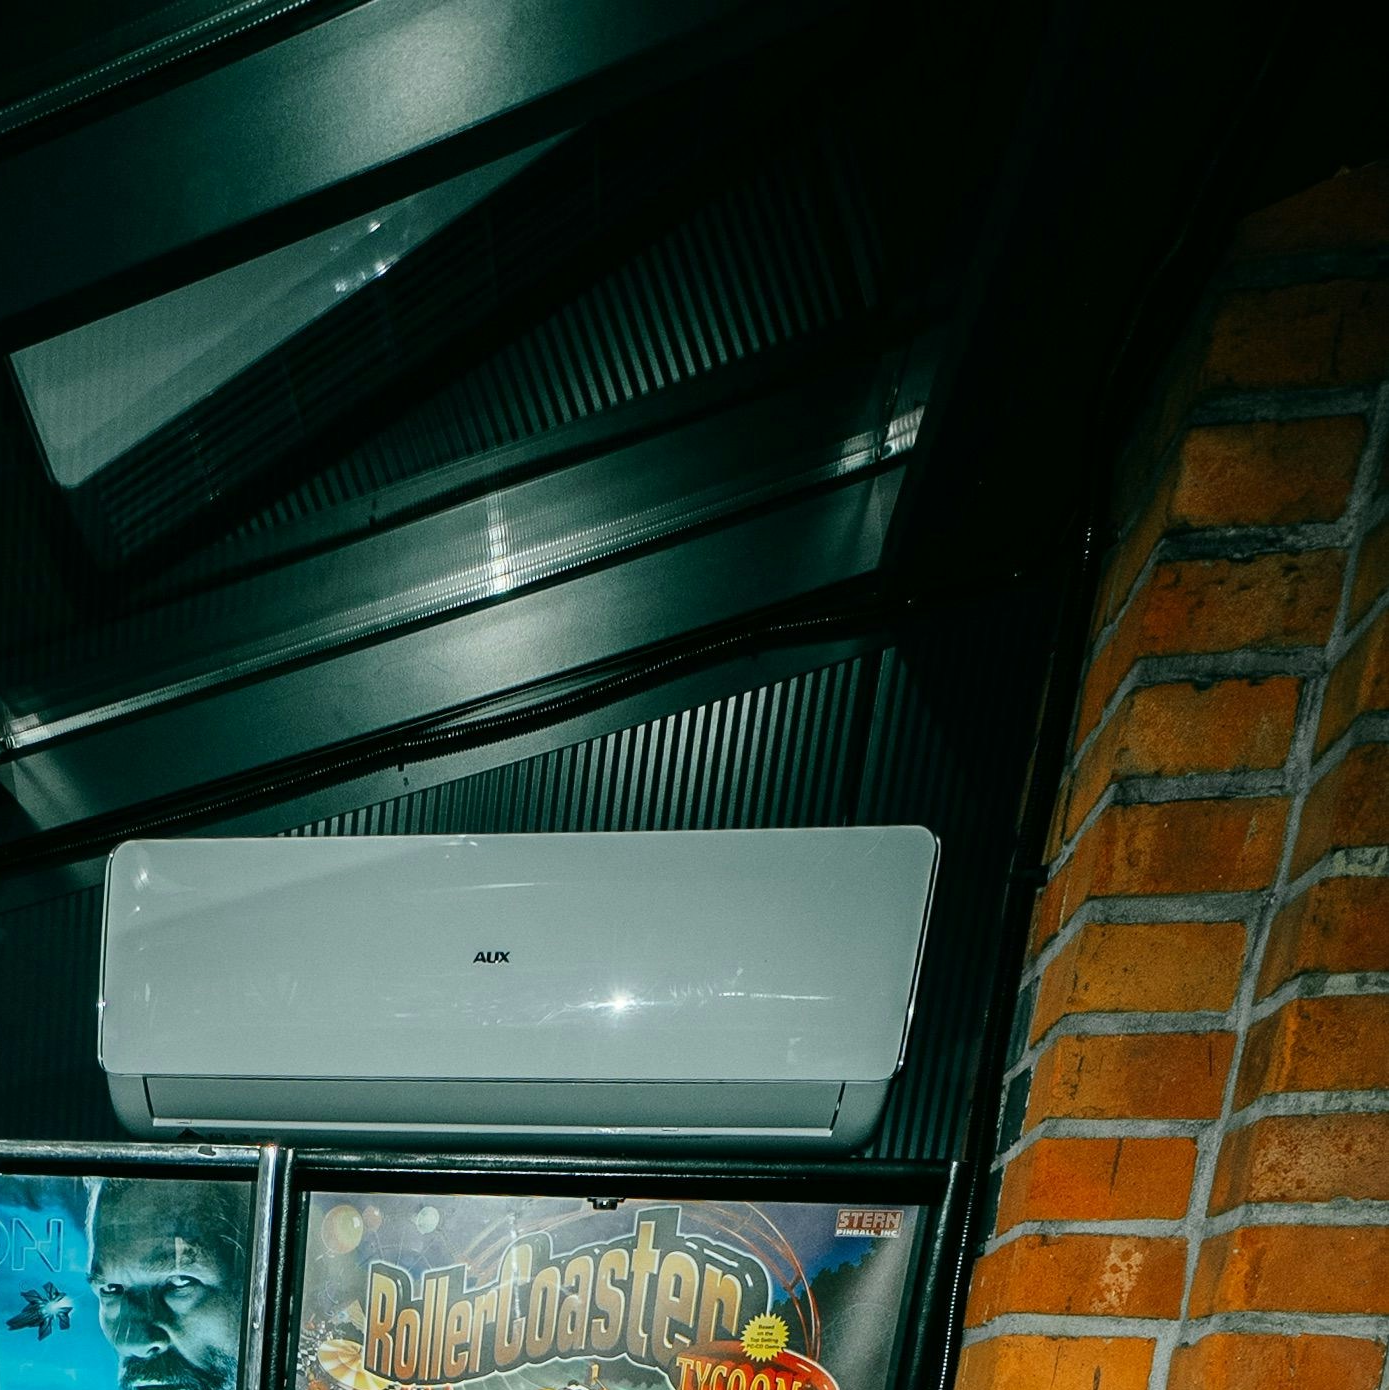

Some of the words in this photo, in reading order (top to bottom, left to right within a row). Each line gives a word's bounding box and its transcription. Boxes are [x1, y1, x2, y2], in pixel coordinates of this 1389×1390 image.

[472, 951, 511, 963] AUX
[838, 1211, 901, 1228] STERN
[365, 1219, 744, 1385] RollerCoaster
